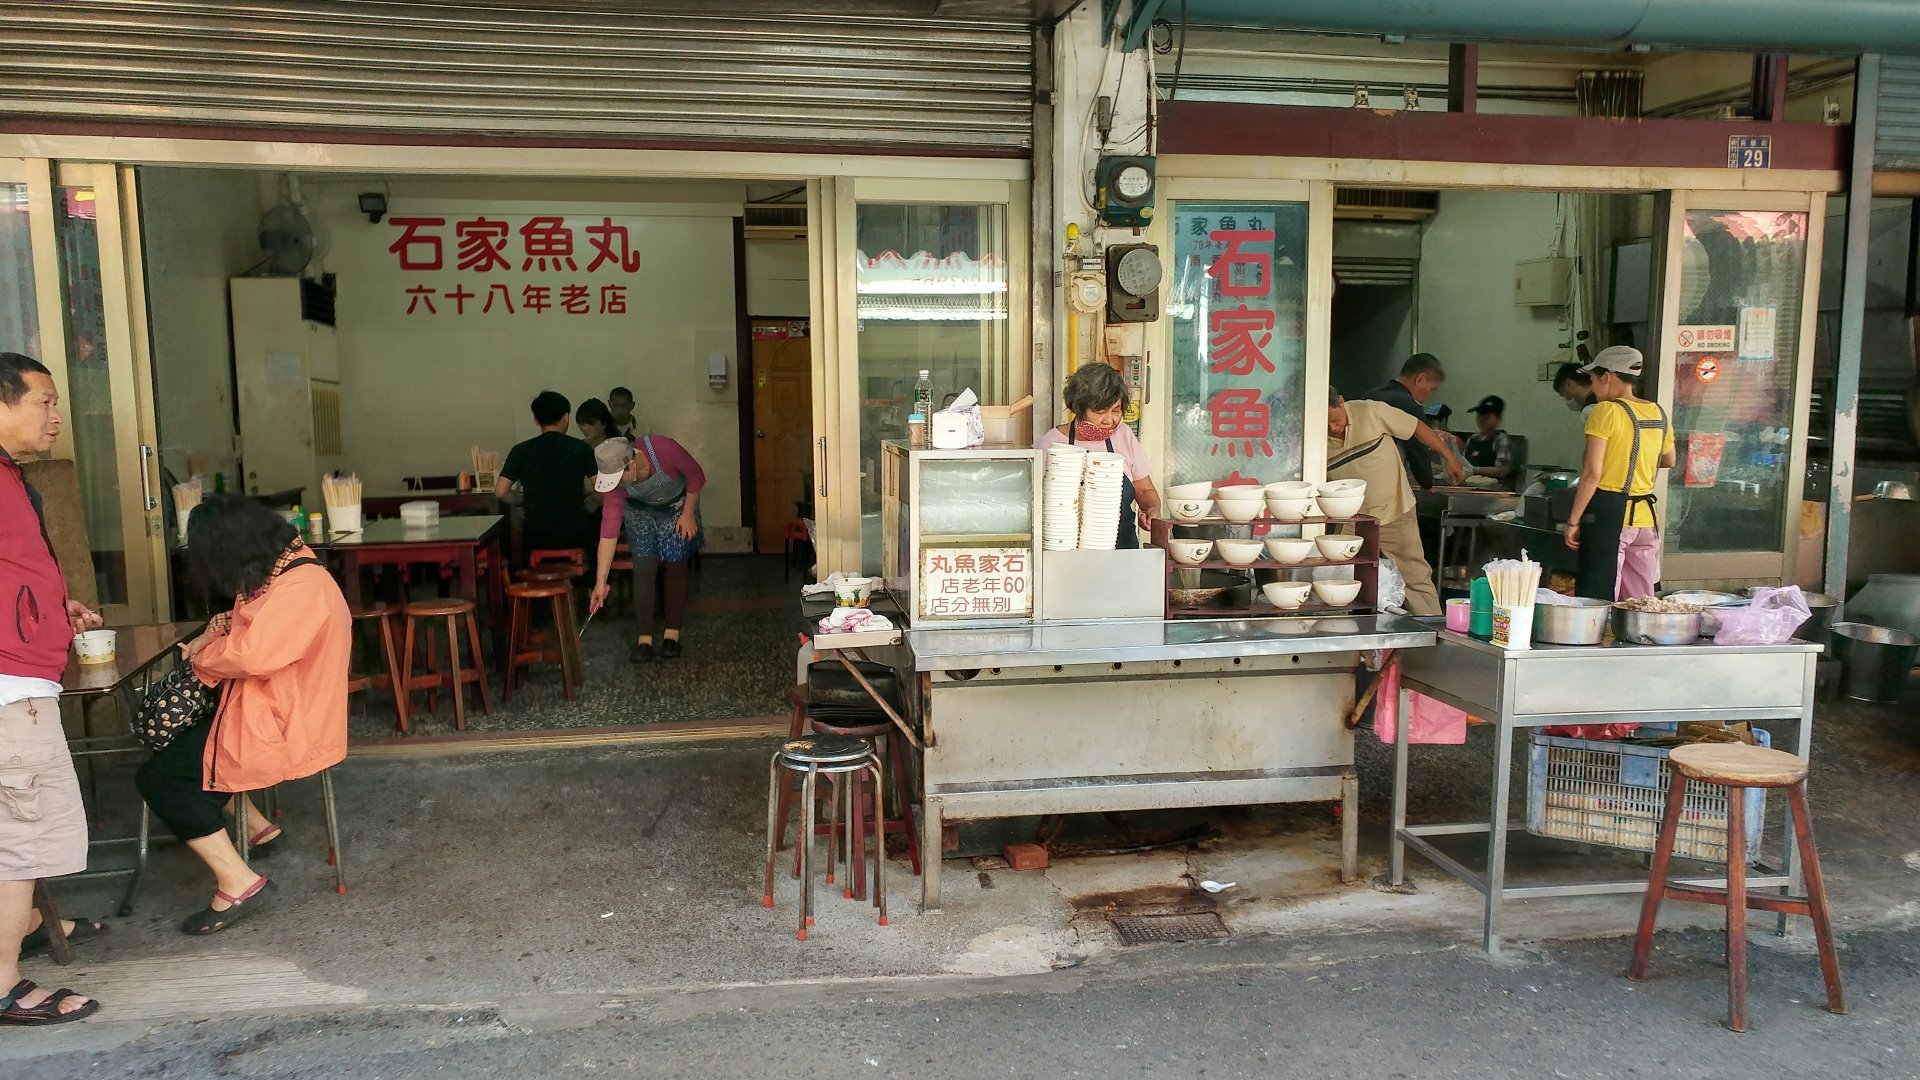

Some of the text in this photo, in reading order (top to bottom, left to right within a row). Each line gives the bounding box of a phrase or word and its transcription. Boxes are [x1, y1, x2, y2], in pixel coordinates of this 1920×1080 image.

[1743, 149, 1763, 168] 29
[388, 216, 640, 273] 石家魚丸
[405, 284, 627, 315] 六十八年老店
